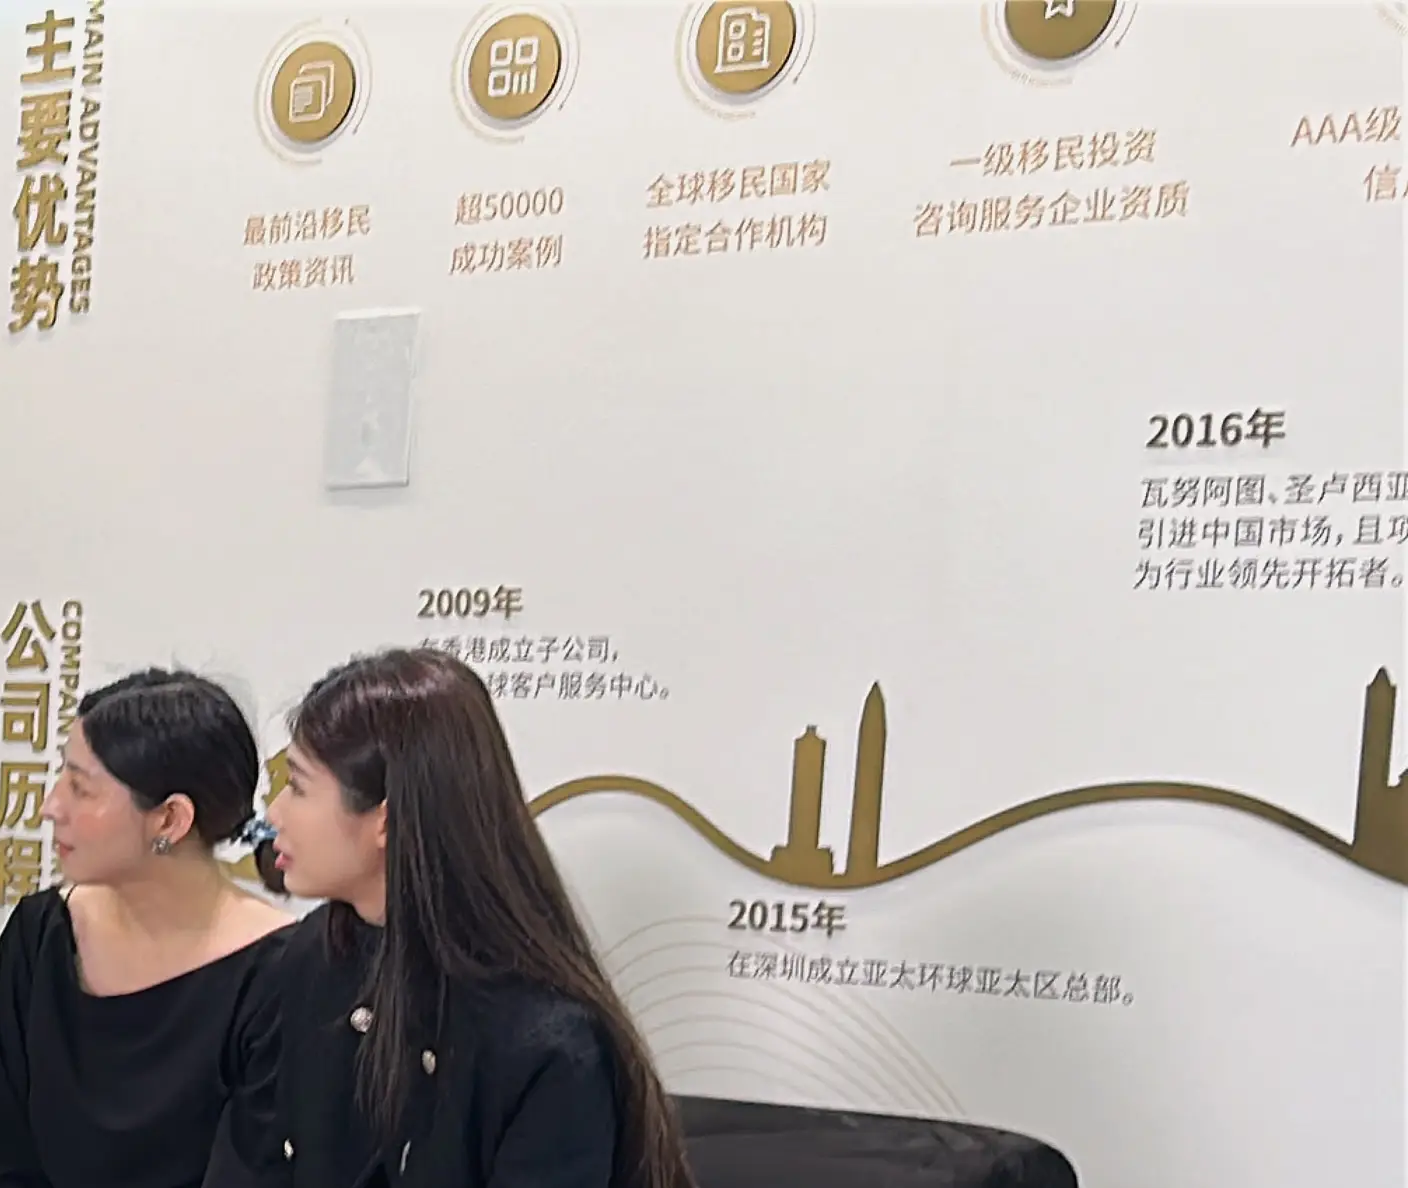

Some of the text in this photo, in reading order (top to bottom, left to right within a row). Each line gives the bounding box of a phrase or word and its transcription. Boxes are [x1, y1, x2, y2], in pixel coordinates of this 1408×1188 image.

[1289, 105, 1402, 148] AAA级
[8, 9, 76, 333] 主要优势
[949, 127, 1158, 178] 一级移民投资
[69, 95, 102, 314] ADVANTAGES
[645, 158, 832, 209] 全球移民国家
[1363, 163, 1408, 203] 信
[242, 204, 372, 247] 最前沿移民
[454, 186, 565, 227] 超50000
[912, 179, 1191, 239] 咨询服务企业资质
[448, 233, 564, 276] 成功案例
[642, 212, 828, 260] 指定合作机构
[251, 254, 356, 293] 政策资讯
[1145, 405, 1287, 450] 2016年
[417, 583, 524, 622] 2009年
[56, 600, 82, 752] COMPAN
[726, 898, 847, 938] 2015年
[726, 949, 1135, 1007] 在深圳成立亚太环球亚太区总部。
